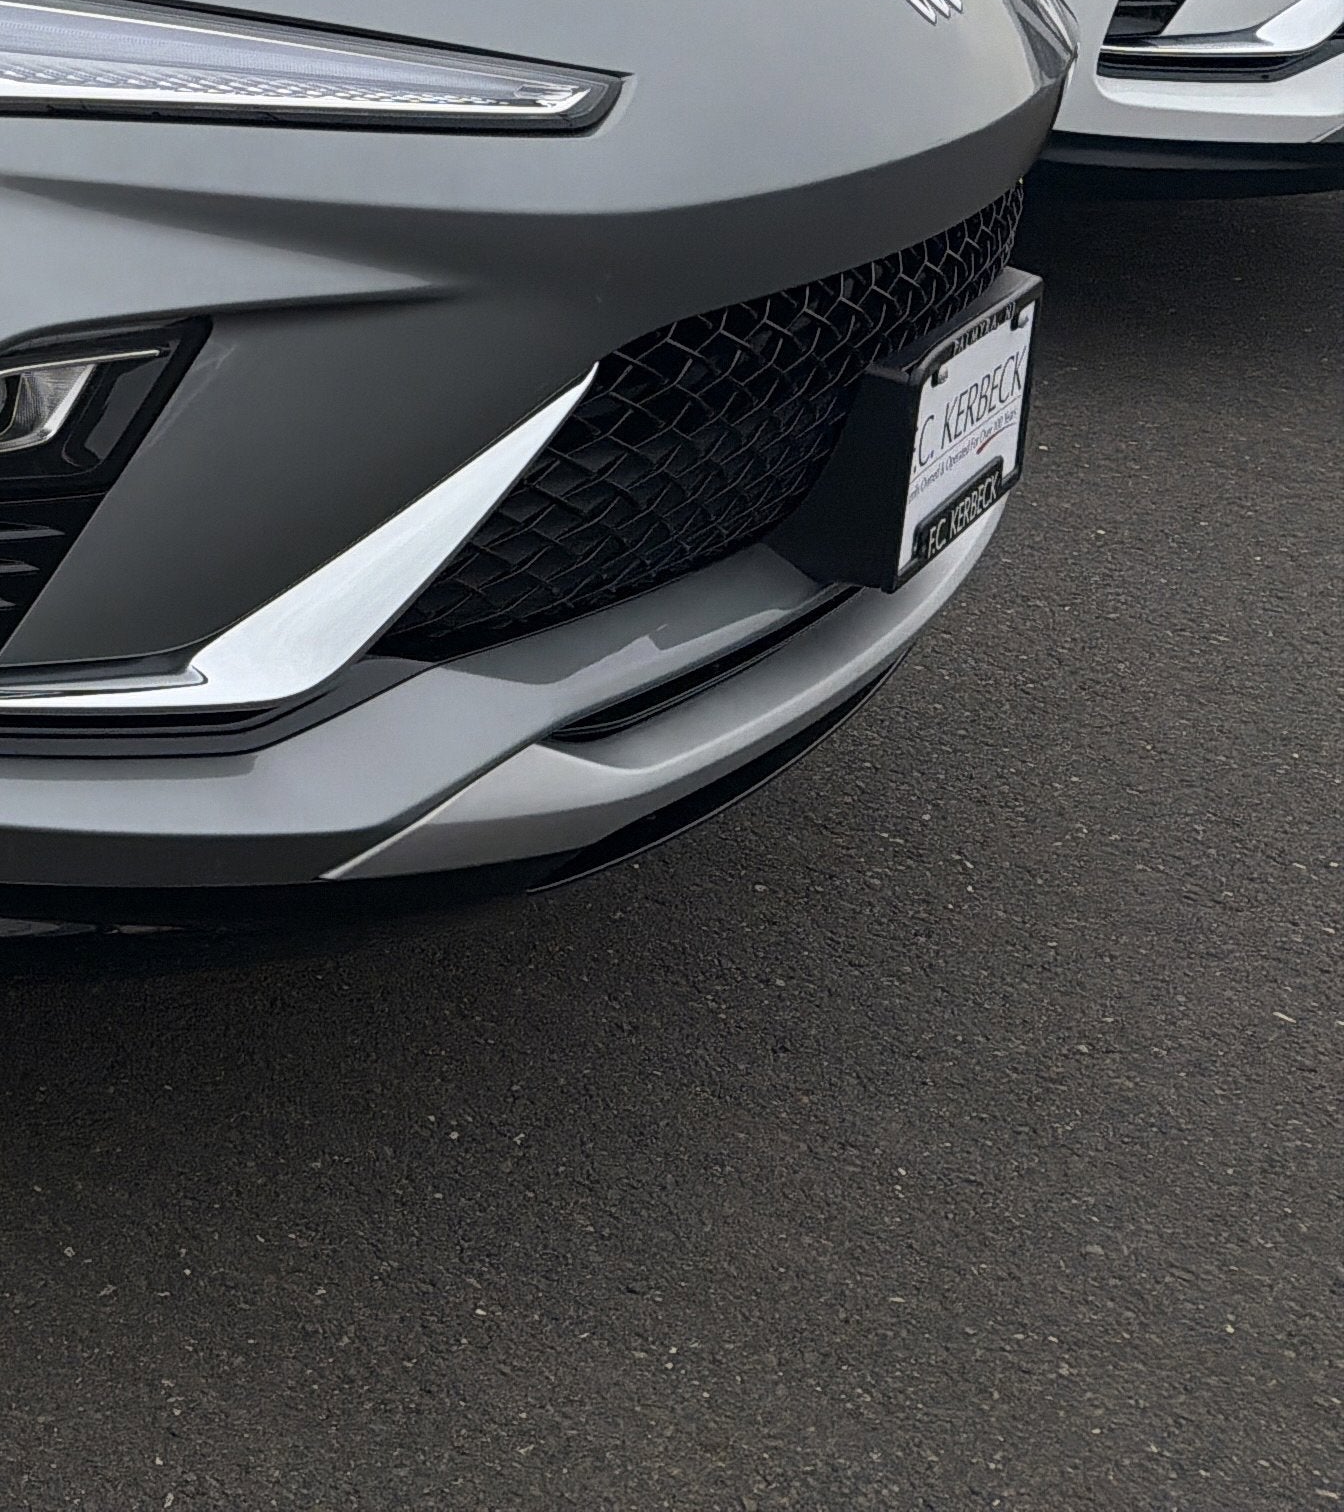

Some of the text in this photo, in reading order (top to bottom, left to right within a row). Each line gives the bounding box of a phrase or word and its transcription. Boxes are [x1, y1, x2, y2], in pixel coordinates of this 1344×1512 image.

[911, 345, 1027, 474] .C. KERBECK
[949, 471, 1000, 540] KERBECK
